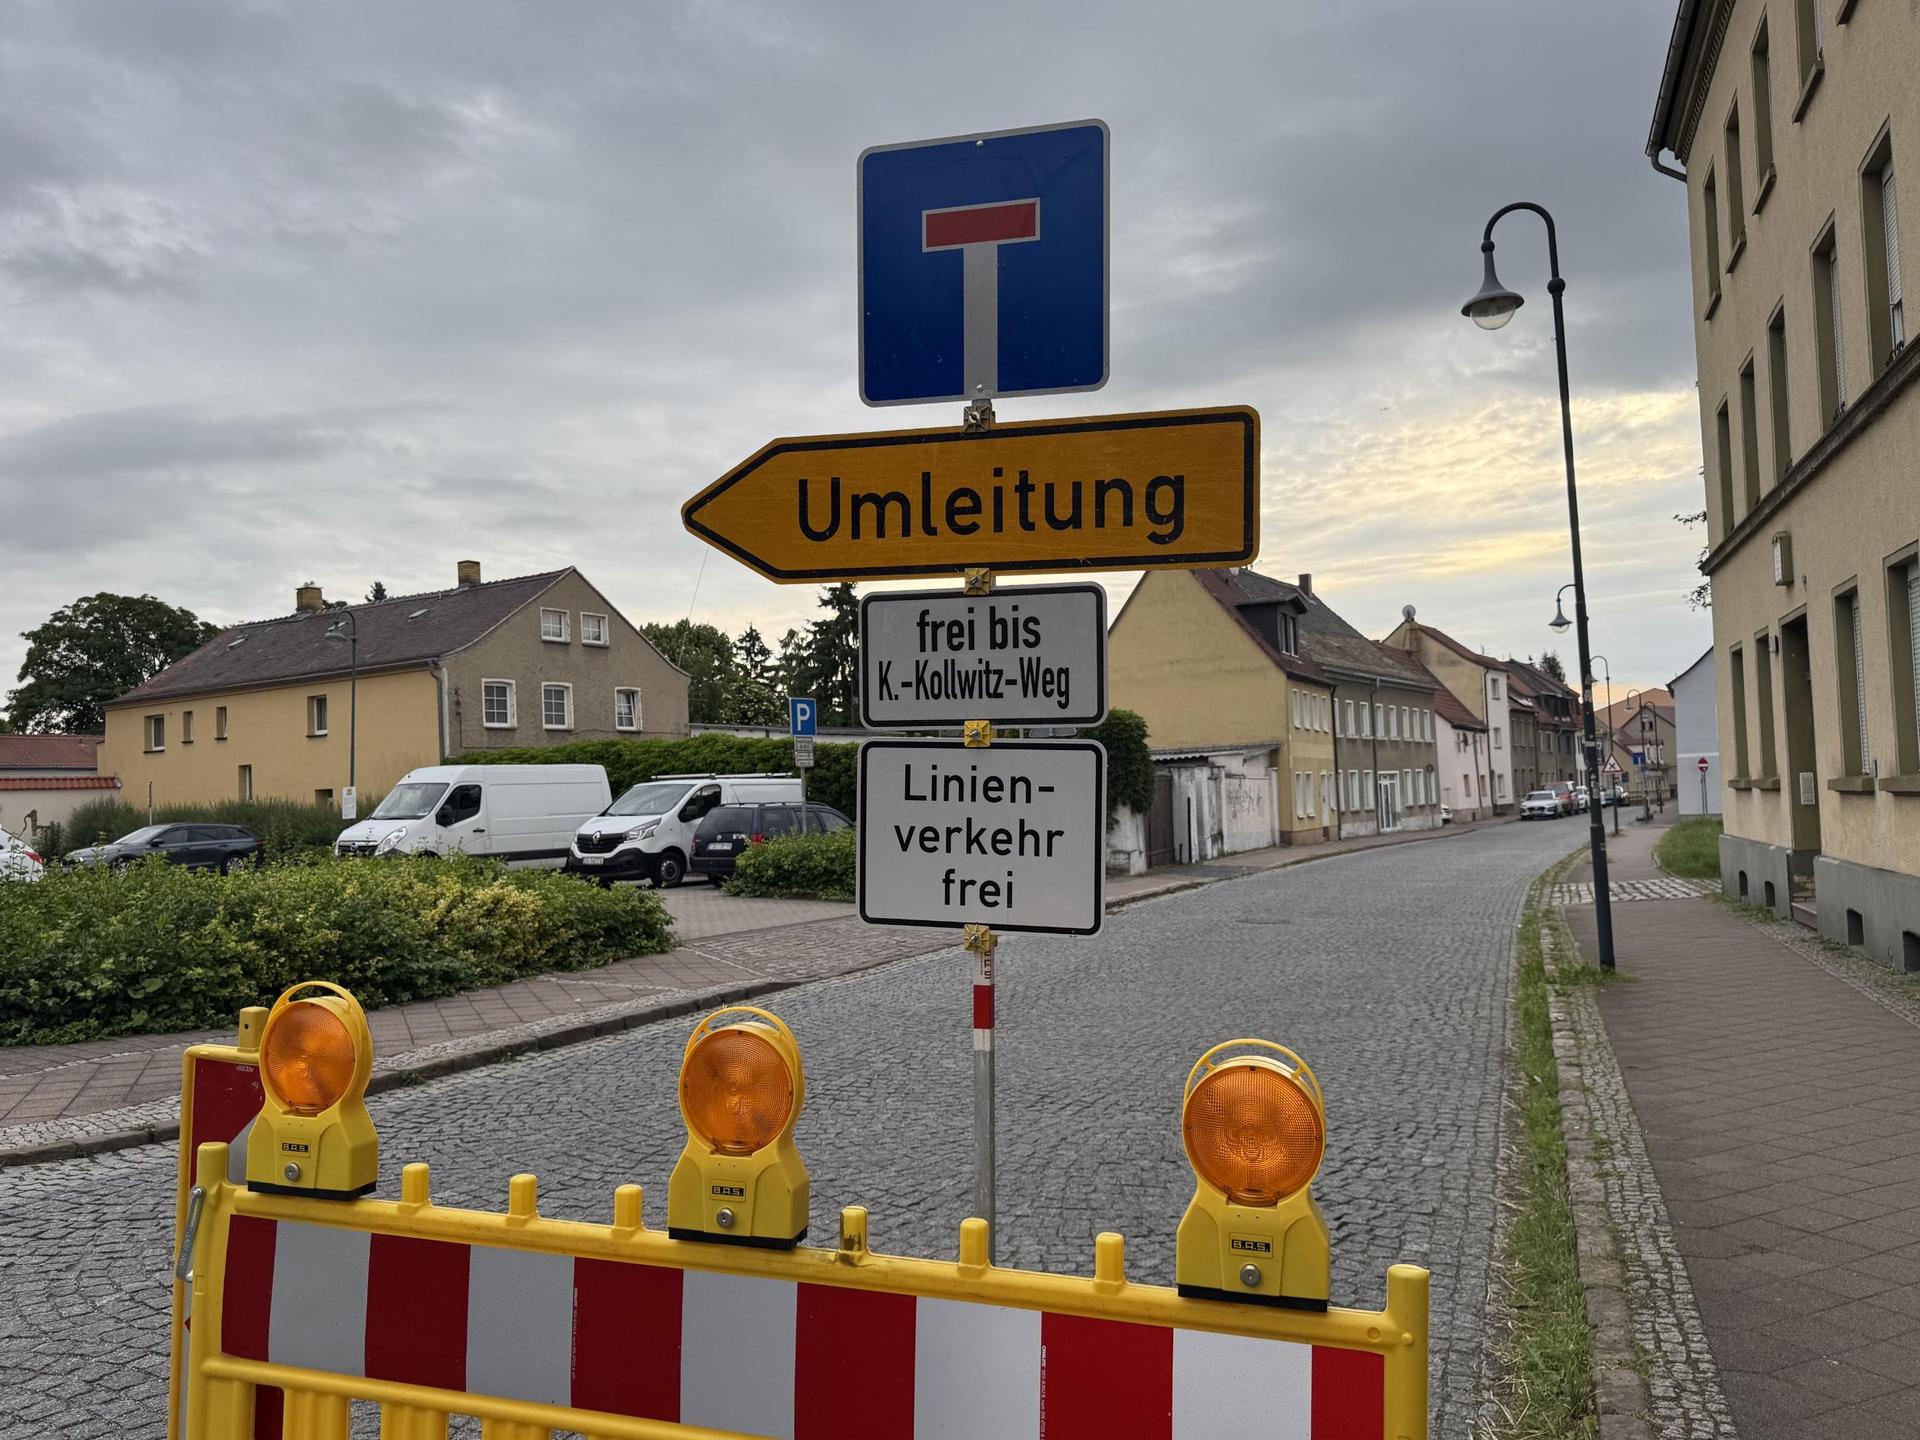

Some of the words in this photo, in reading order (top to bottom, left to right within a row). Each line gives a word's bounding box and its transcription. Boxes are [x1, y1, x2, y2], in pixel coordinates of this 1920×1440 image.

[798, 467, 1185, 545] Umleitung
[916, 607, 976, 653] frei
[989, 605, 1041, 650] bis
[878, 656, 1070, 709] K.-Kollwitz-Weg
[796, 703, 810, 731] P
[903, 763, 1056, 805] Linien-
[894, 817, 1065, 858] verkehr
[942, 868, 1014, 909] frei
[1233, 1240, 1270, 1253] B.A.S.
